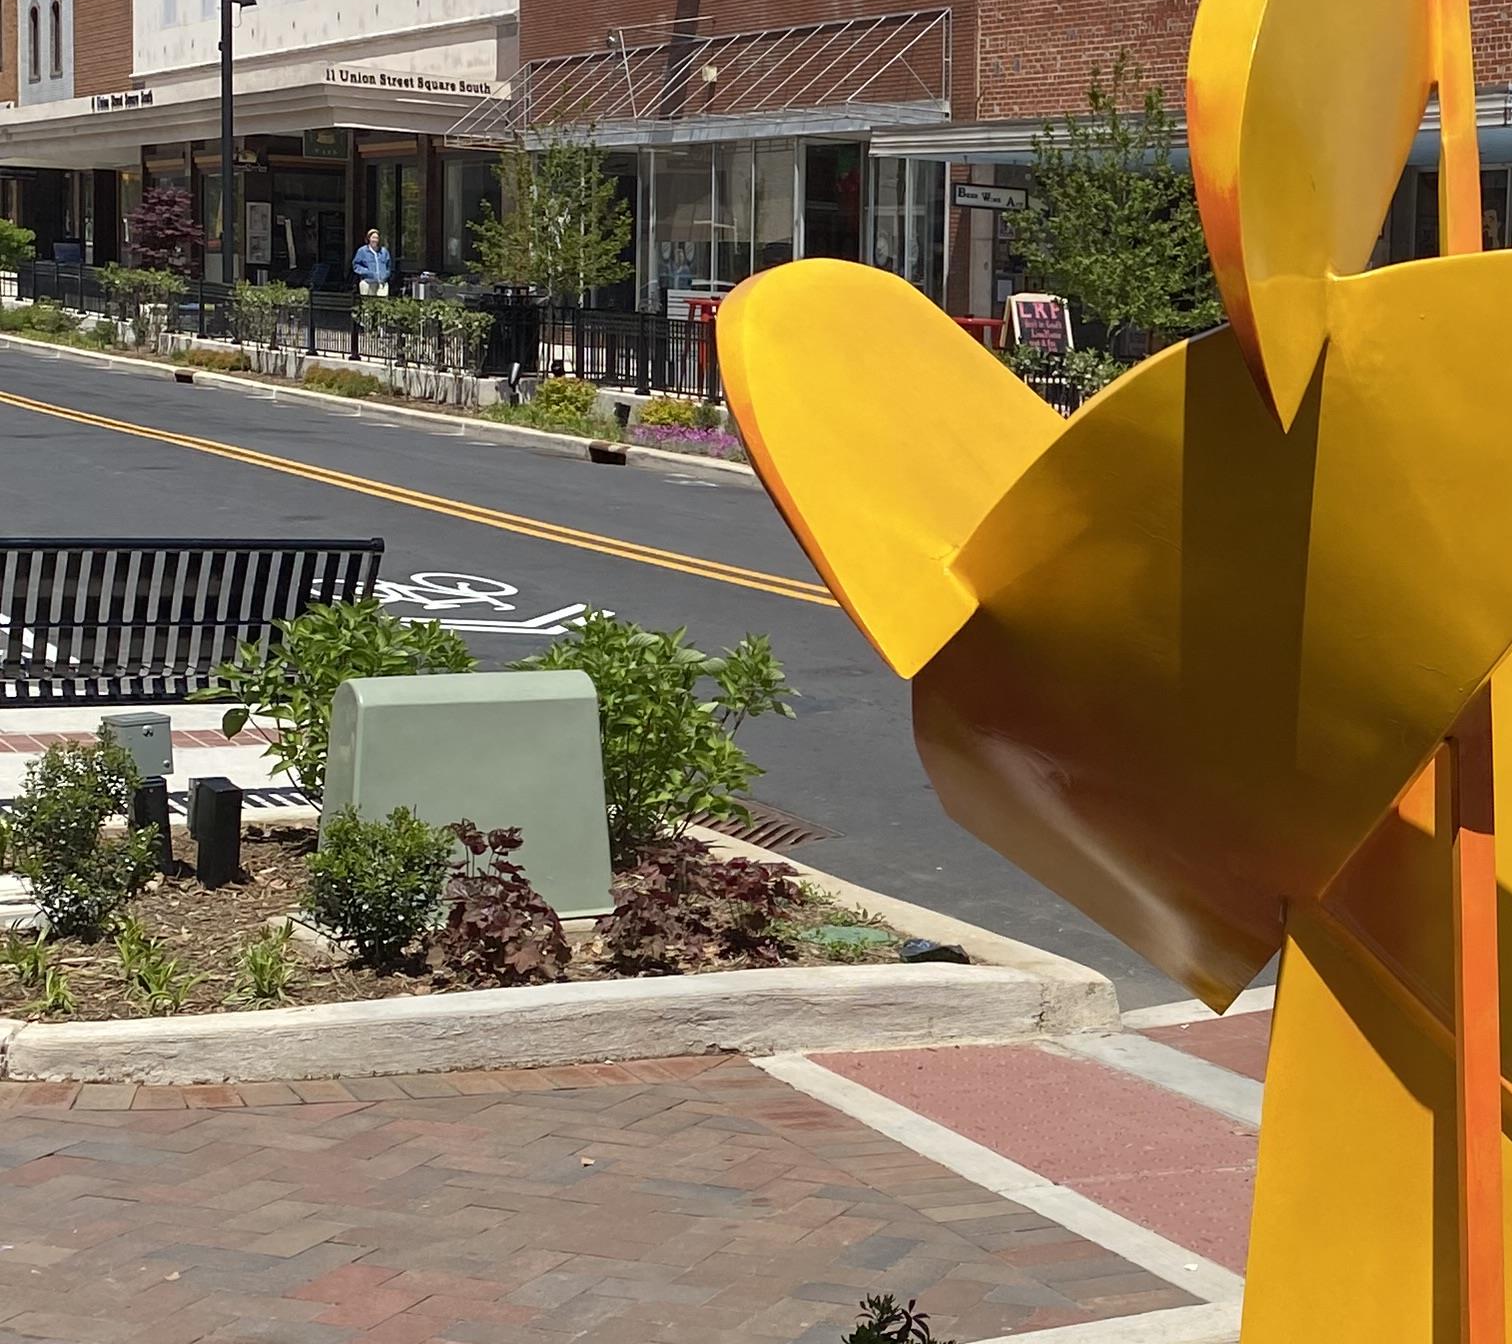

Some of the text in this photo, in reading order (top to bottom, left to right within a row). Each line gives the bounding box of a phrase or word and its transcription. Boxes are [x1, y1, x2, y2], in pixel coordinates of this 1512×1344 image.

[339, 69, 377, 85] Union
[379, 73, 414, 89] Street
[417, 76, 457, 93] Square
[459, 80, 492, 95] South
